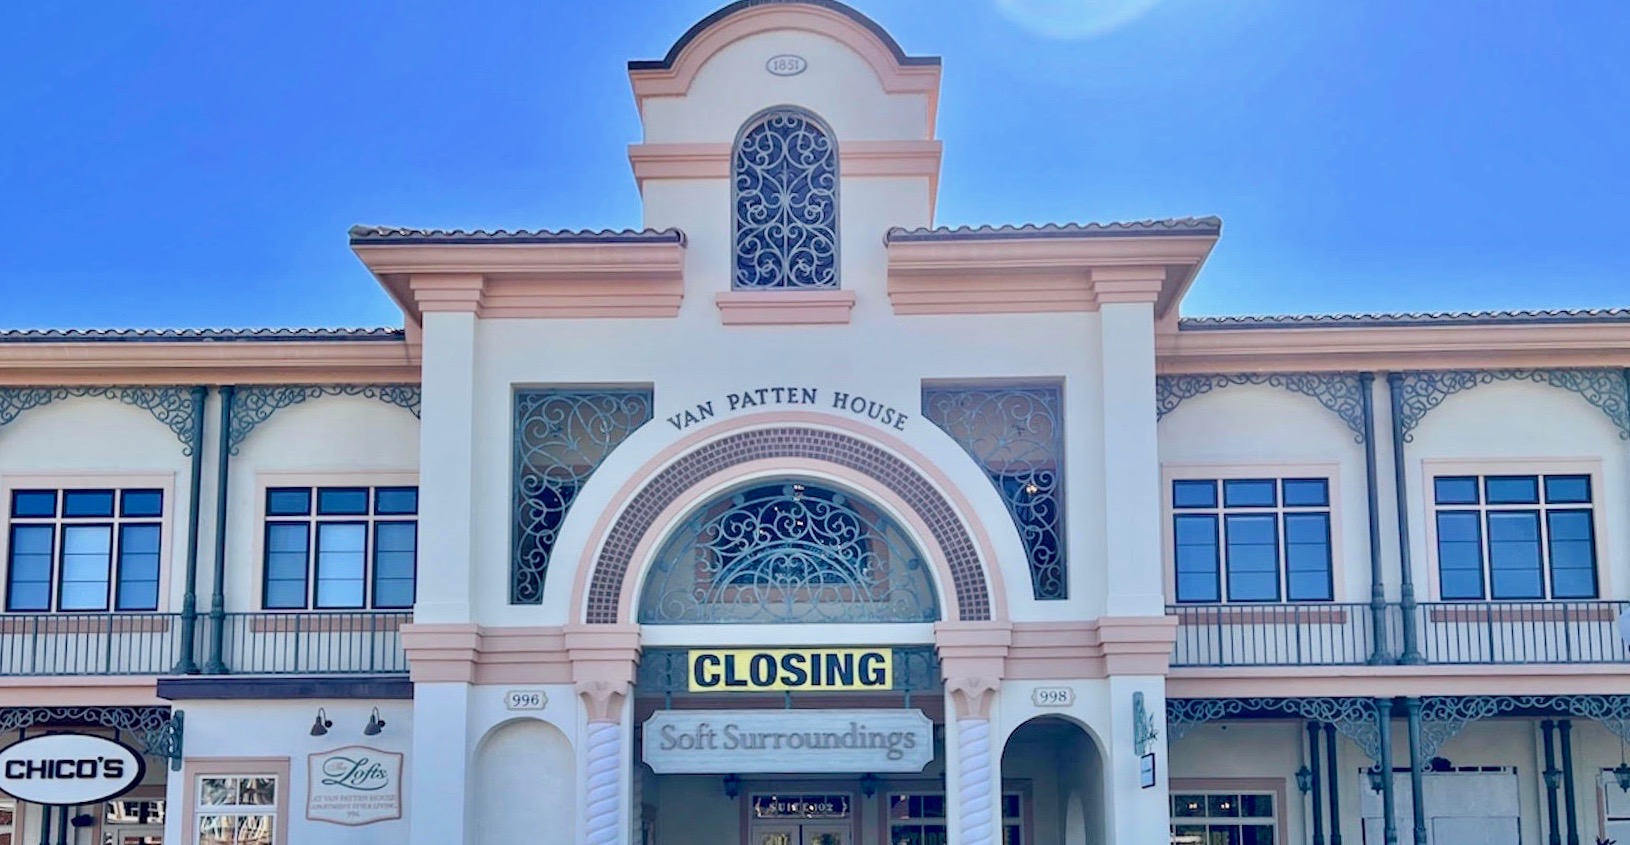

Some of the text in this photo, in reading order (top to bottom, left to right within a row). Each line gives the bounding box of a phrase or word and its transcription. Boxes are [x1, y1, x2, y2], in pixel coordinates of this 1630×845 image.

[773, 59, 799, 71] 1851
[667, 387, 908, 432] VAN PATTEN HOUSE
[693, 652, 887, 688] CLOSING
[512, 693, 540, 708] 996
[1040, 690, 1067, 704] 998
[660, 721, 917, 761] Soft Surroundings
[5, 756, 124, 779] CHICO'S
[321, 756, 389, 791] Lofts
